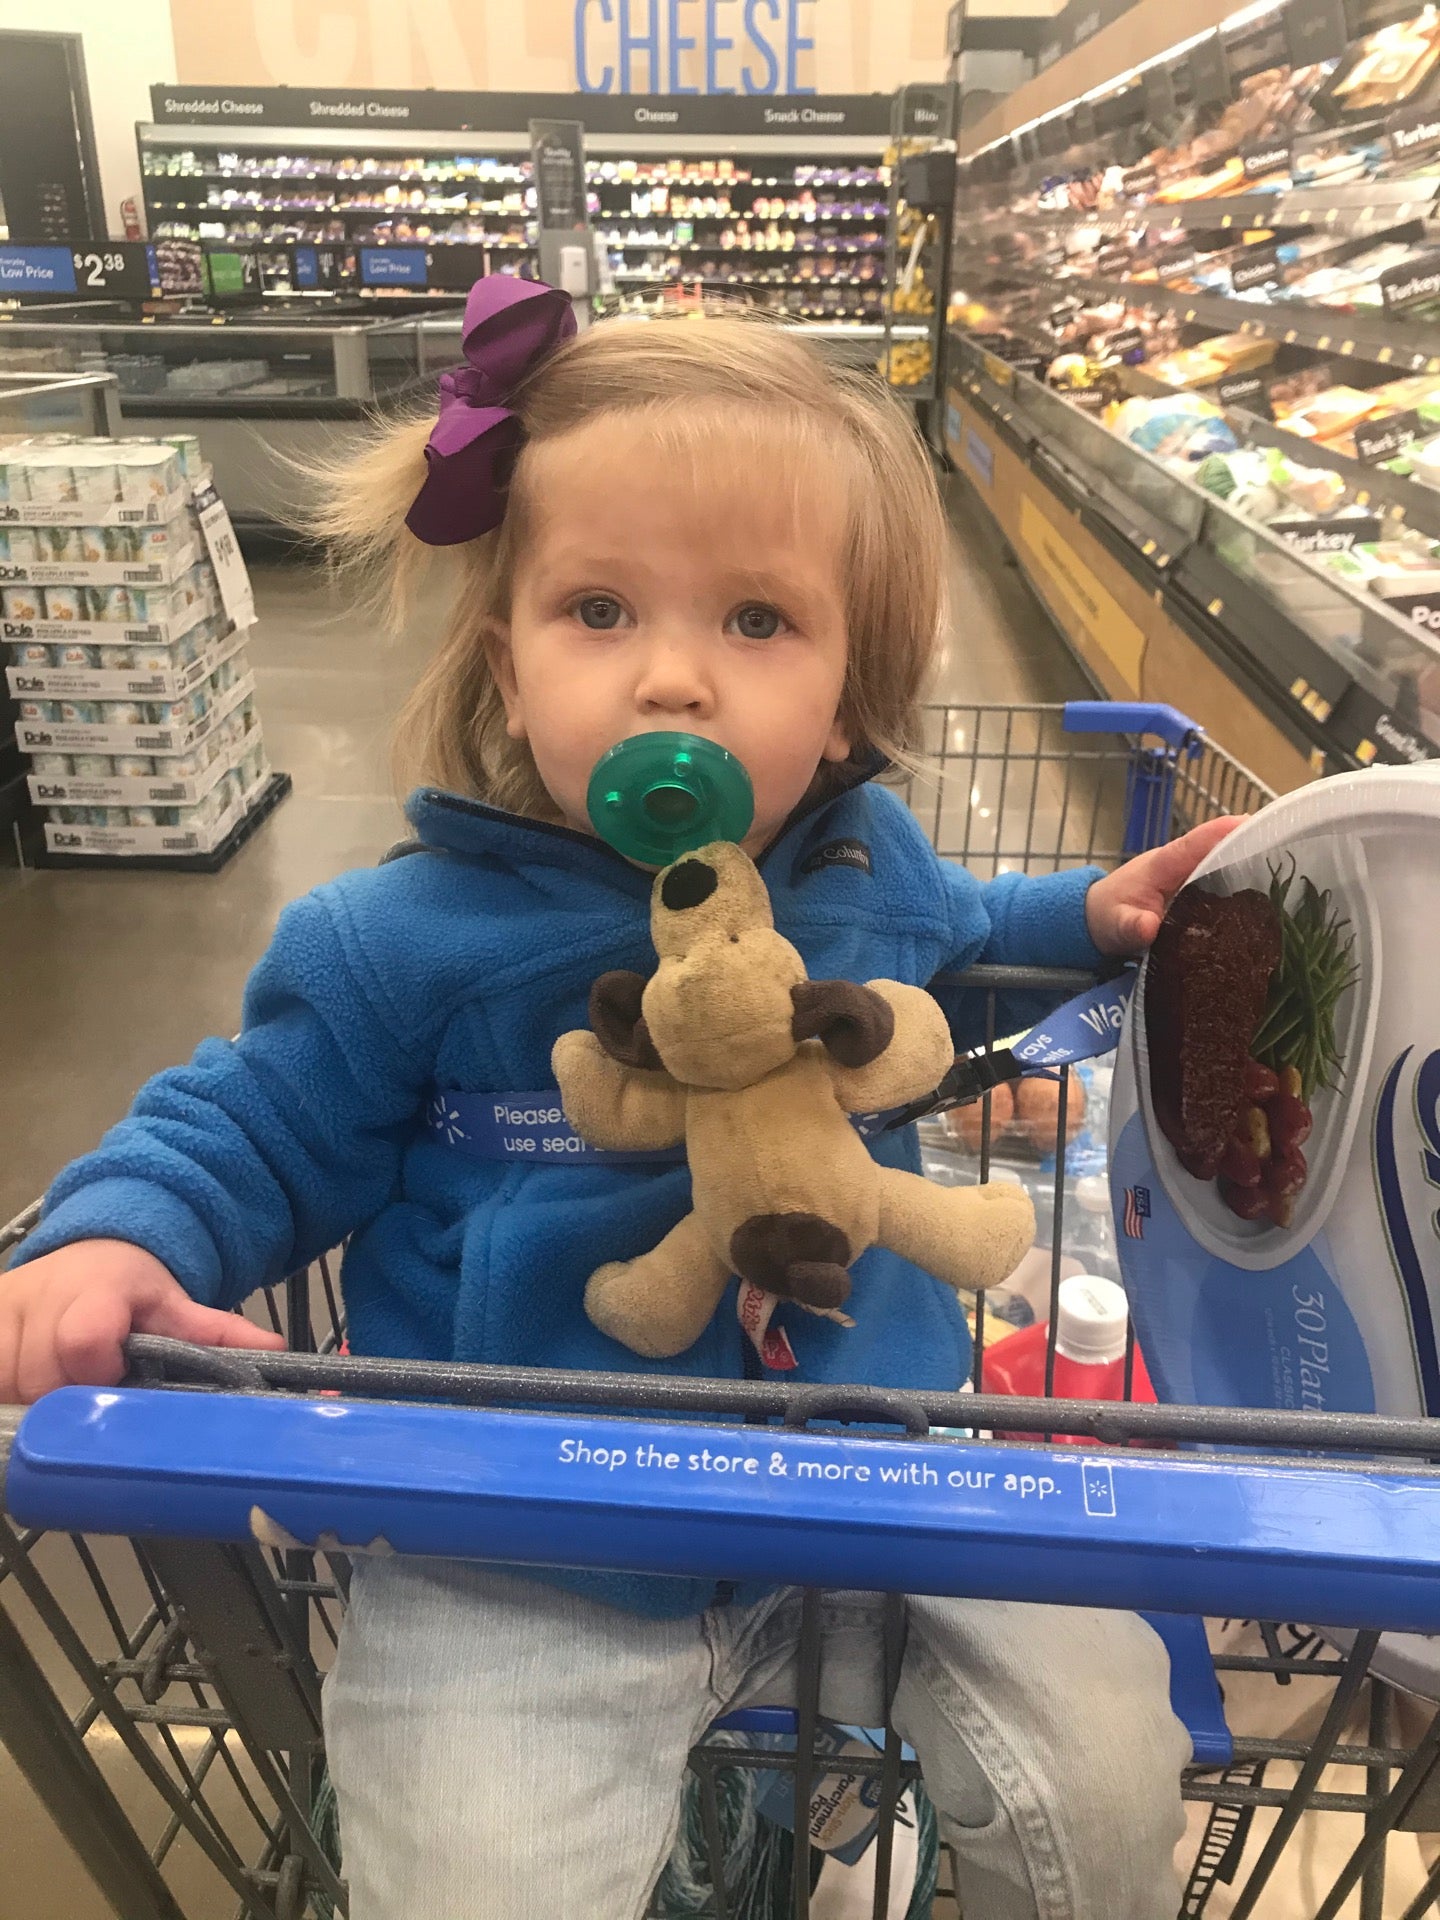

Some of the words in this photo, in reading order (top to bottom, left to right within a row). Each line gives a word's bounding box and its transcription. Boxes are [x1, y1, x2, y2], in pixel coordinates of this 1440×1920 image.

[574, 0, 817, 94] CHEESE
[165, 98, 219, 113] Shredded
[221, 99, 264, 114] Cheese
[310, 101, 365, 117] Shredded
[367, 102, 409, 117] Cheese
[634, 108, 679, 122] Cheese
[764, 108, 799, 123] Snack
[801, 109, 845, 123] Cheese
[1, 265, 23, 279] Low
[26, 265, 54, 279] Price
[1386, 274, 1440, 302] Turkey
[1360, 430, 1415, 455] Turky
[1284, 529, 1356, 552] Turkey
[4, 623, 34, 637] Dole
[16, 677, 45, 690] Dole
[24, 731, 52, 744] Dole
[38, 784, 66, 797] Dole
[54, 832, 82, 845] Dole
[1037, 1048, 1074, 1064] elts.
[504, 1137, 537, 1152] use
[1292, 1284, 1327, 1332] 30
[1279, 1345, 1295, 1409] CLASSIC
[558, 1439, 627, 1472] Shop
[636, 1444, 681, 1470] the
[688, 1449, 760, 1475] store
[768, 1451, 788, 1477] &
[797, 1461, 871, 1482] more
[879, 1462, 938, 1486] with
[947, 1469, 996, 1489] our
[1003, 1473, 1063, 1500] app.
